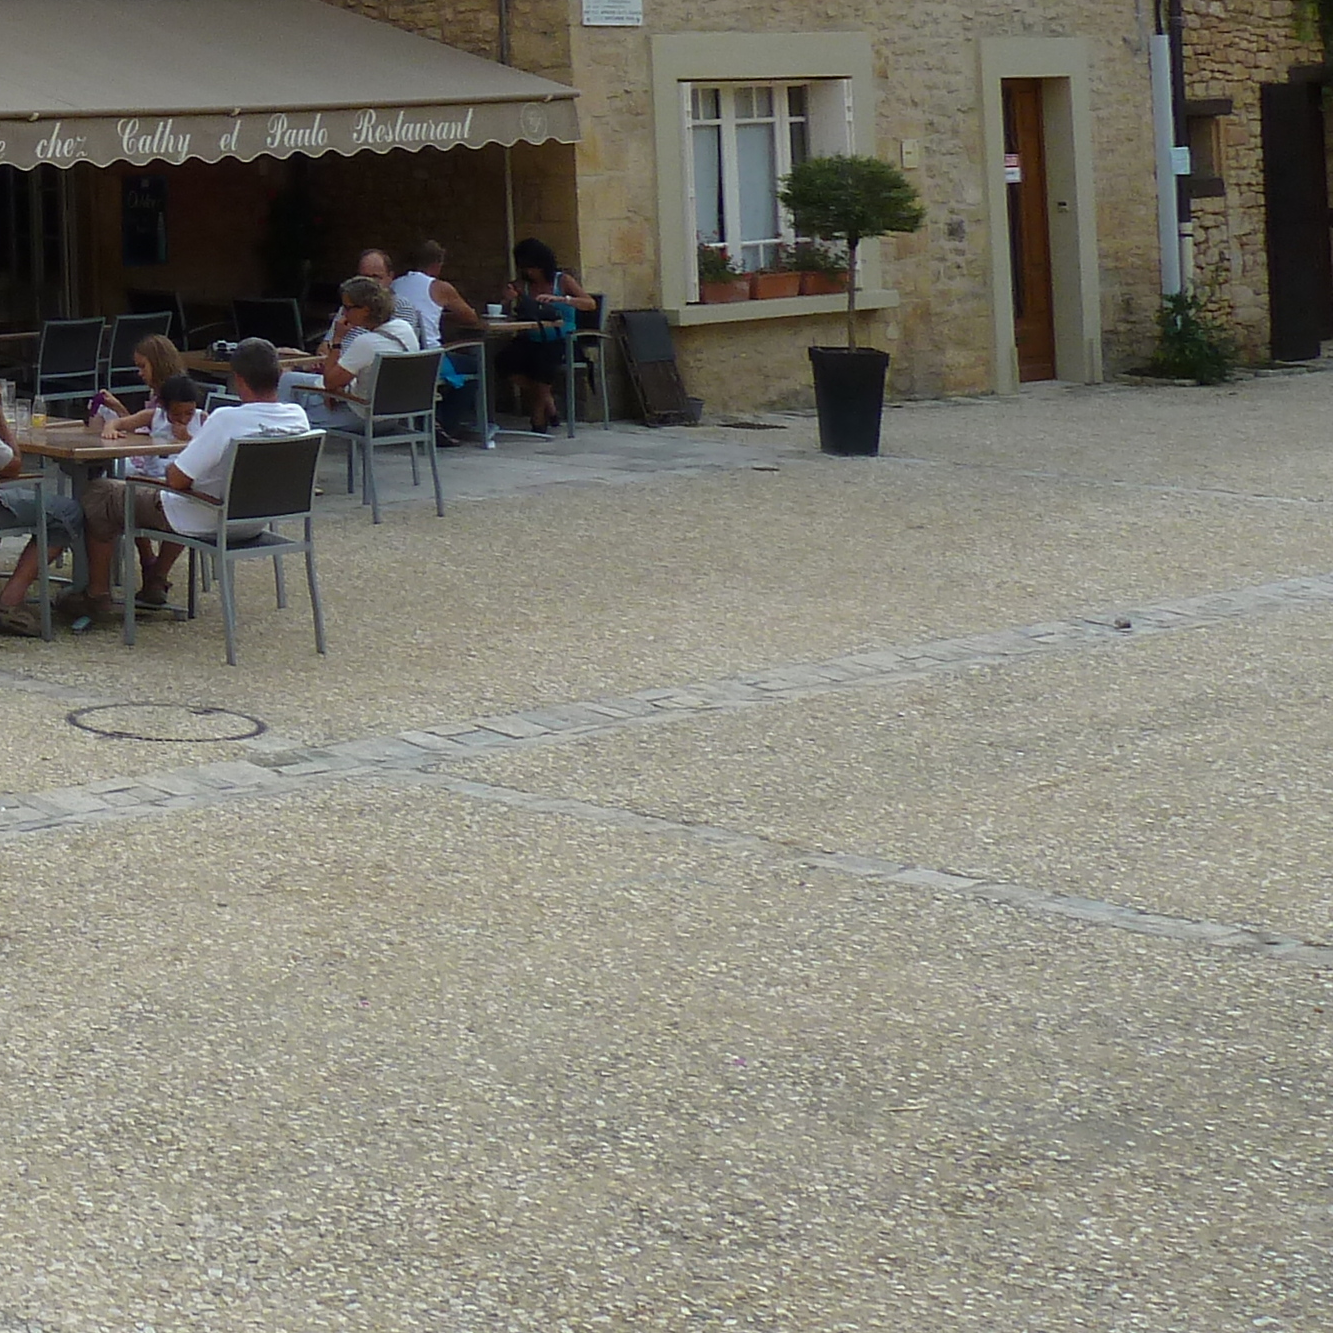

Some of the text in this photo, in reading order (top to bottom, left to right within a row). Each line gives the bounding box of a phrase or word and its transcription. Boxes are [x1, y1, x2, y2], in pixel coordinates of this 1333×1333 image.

[35, 122, 88, 159] chez
[117, 118, 191, 162] Cathy
[220, 119, 241, 152] et
[266, 113, 328, 149] Paulo
[352, 107, 474, 144] Restaurant
